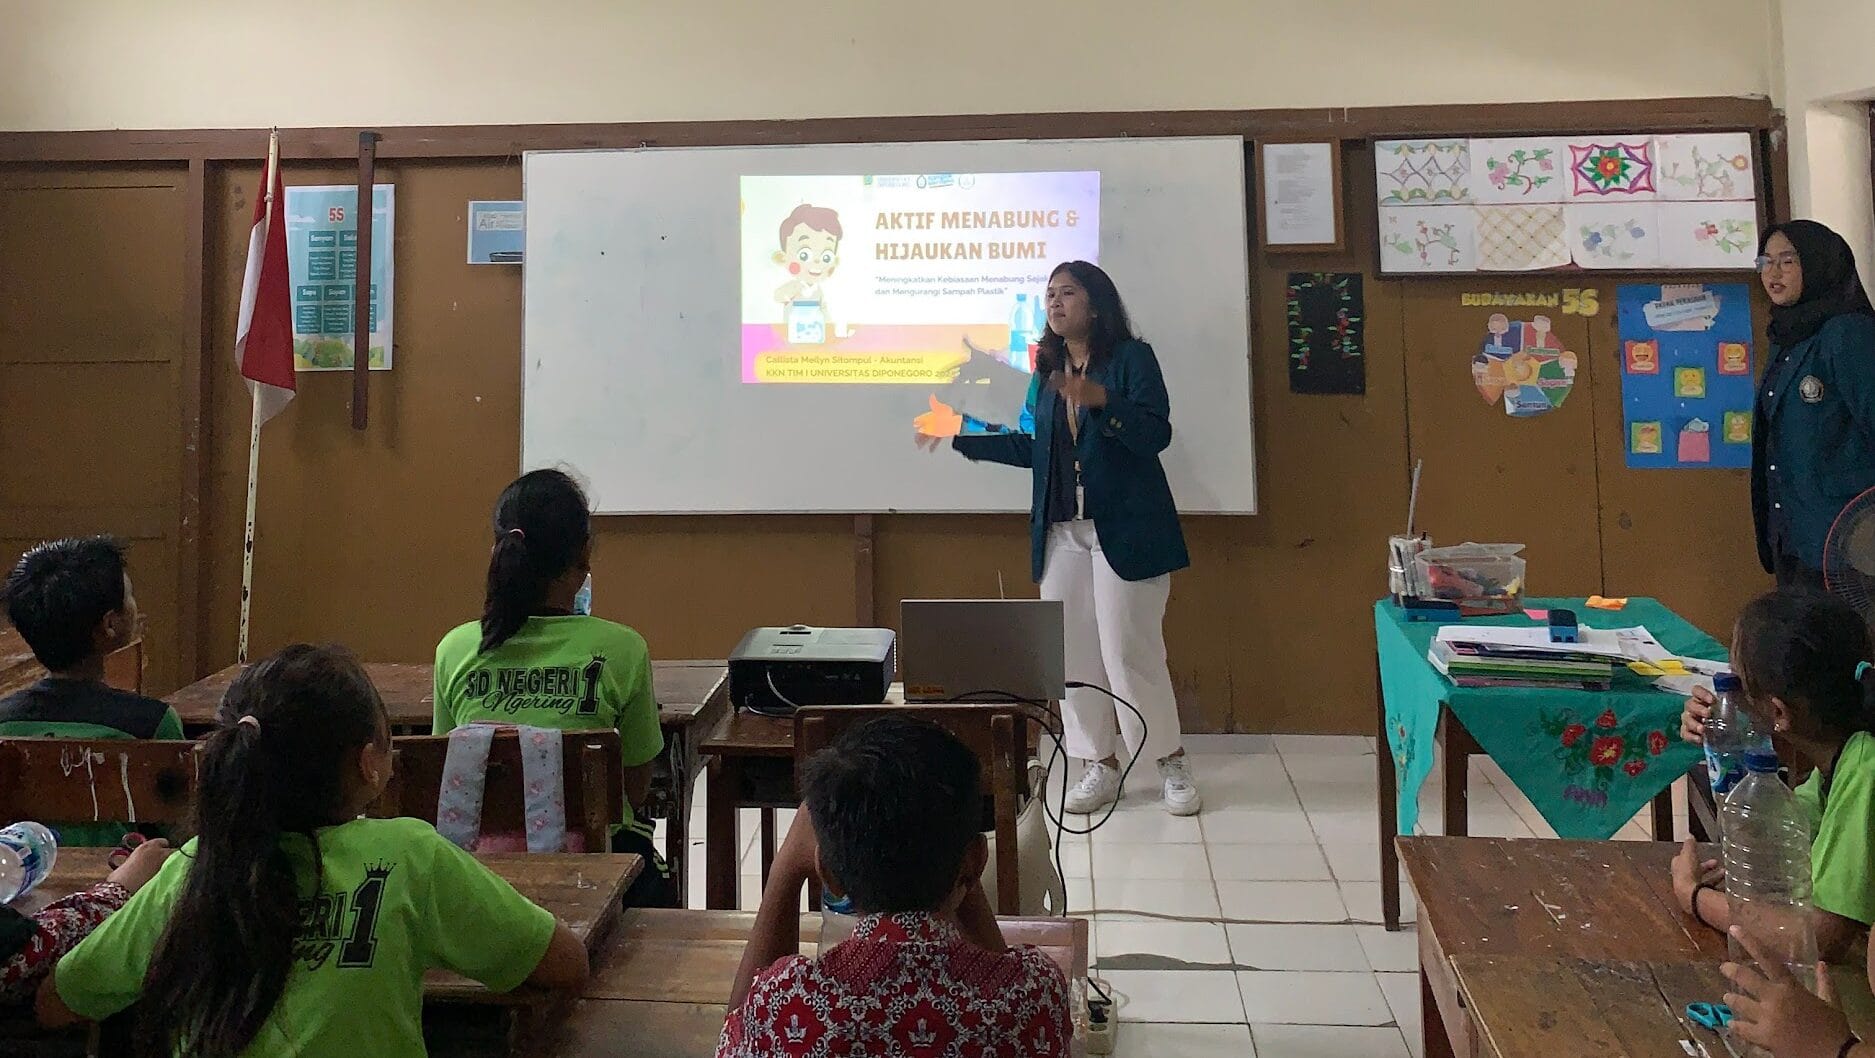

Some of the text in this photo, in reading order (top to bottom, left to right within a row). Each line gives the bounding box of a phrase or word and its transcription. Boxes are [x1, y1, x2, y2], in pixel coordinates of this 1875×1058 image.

[329, 207, 345, 222] 5S
[875, 210, 1080, 230] AKTIF MENABUNG &
[875, 241, 1047, 260] HIJAUKAN BUMI
[875, 276, 936, 285] "Meningkatkan
[937, 275, 980, 284] Kebiasaan
[981, 275, 1025, 285] Menabung
[874, 287, 891, 295] dan
[892, 287, 941, 297] Mengurangi
[942, 287, 976, 297] Sampah
[1561, 288, 1599, 316] 5S
[766, 355, 799, 364] Callista
[831, 355, 872, 366] Sitompul
[879, 355, 924, 364] Akuntansi
[766, 369, 785, 377] KKN
[788, 369, 803, 377] TIM
[810, 369, 870, 377] UNIVERSITAS
[872, 369, 933, 378] DIPONEGORO
[464, 660, 606, 715] SD NEGERI 1
[481, 690, 577, 715] Ngering
[336, 877, 386, 968] 1
